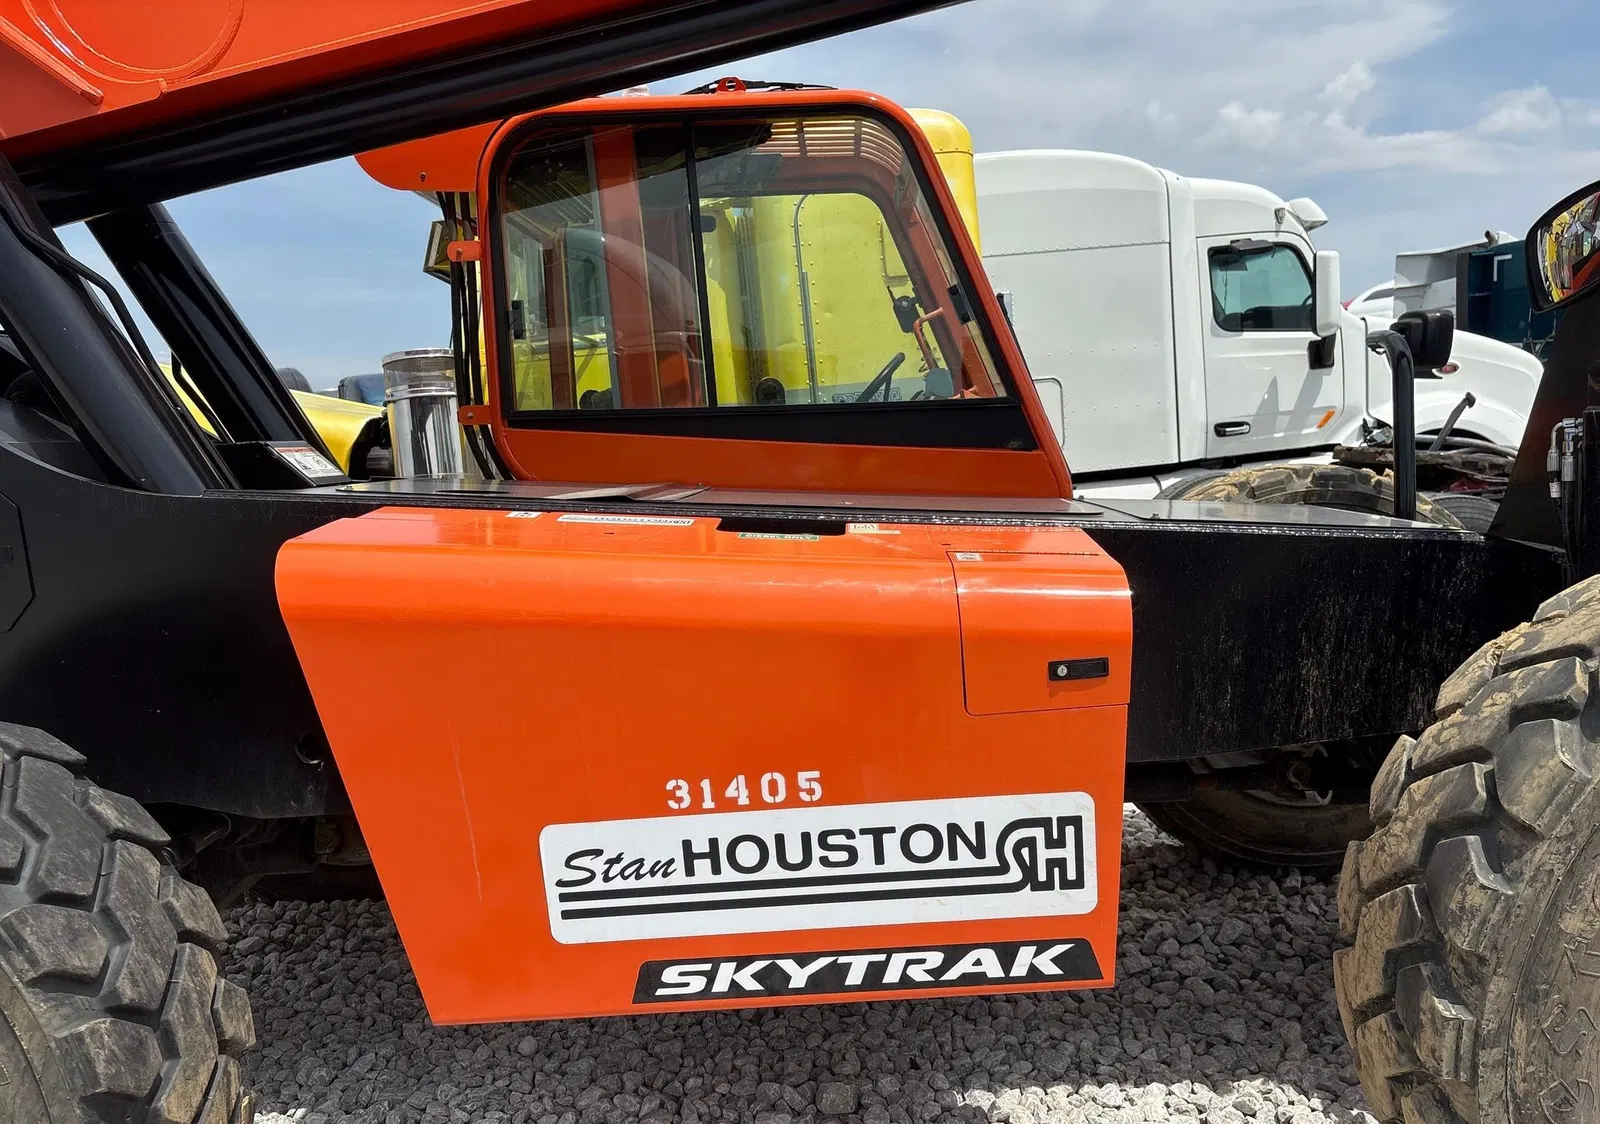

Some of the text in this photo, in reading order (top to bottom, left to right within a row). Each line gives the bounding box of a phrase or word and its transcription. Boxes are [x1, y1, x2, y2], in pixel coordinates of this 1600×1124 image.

[665, 770, 824, 811] 31405
[555, 848, 676, 888] Stan
[681, 820, 987, 878] HOUSTON
[654, 943, 1076, 996] SKYTRAK
